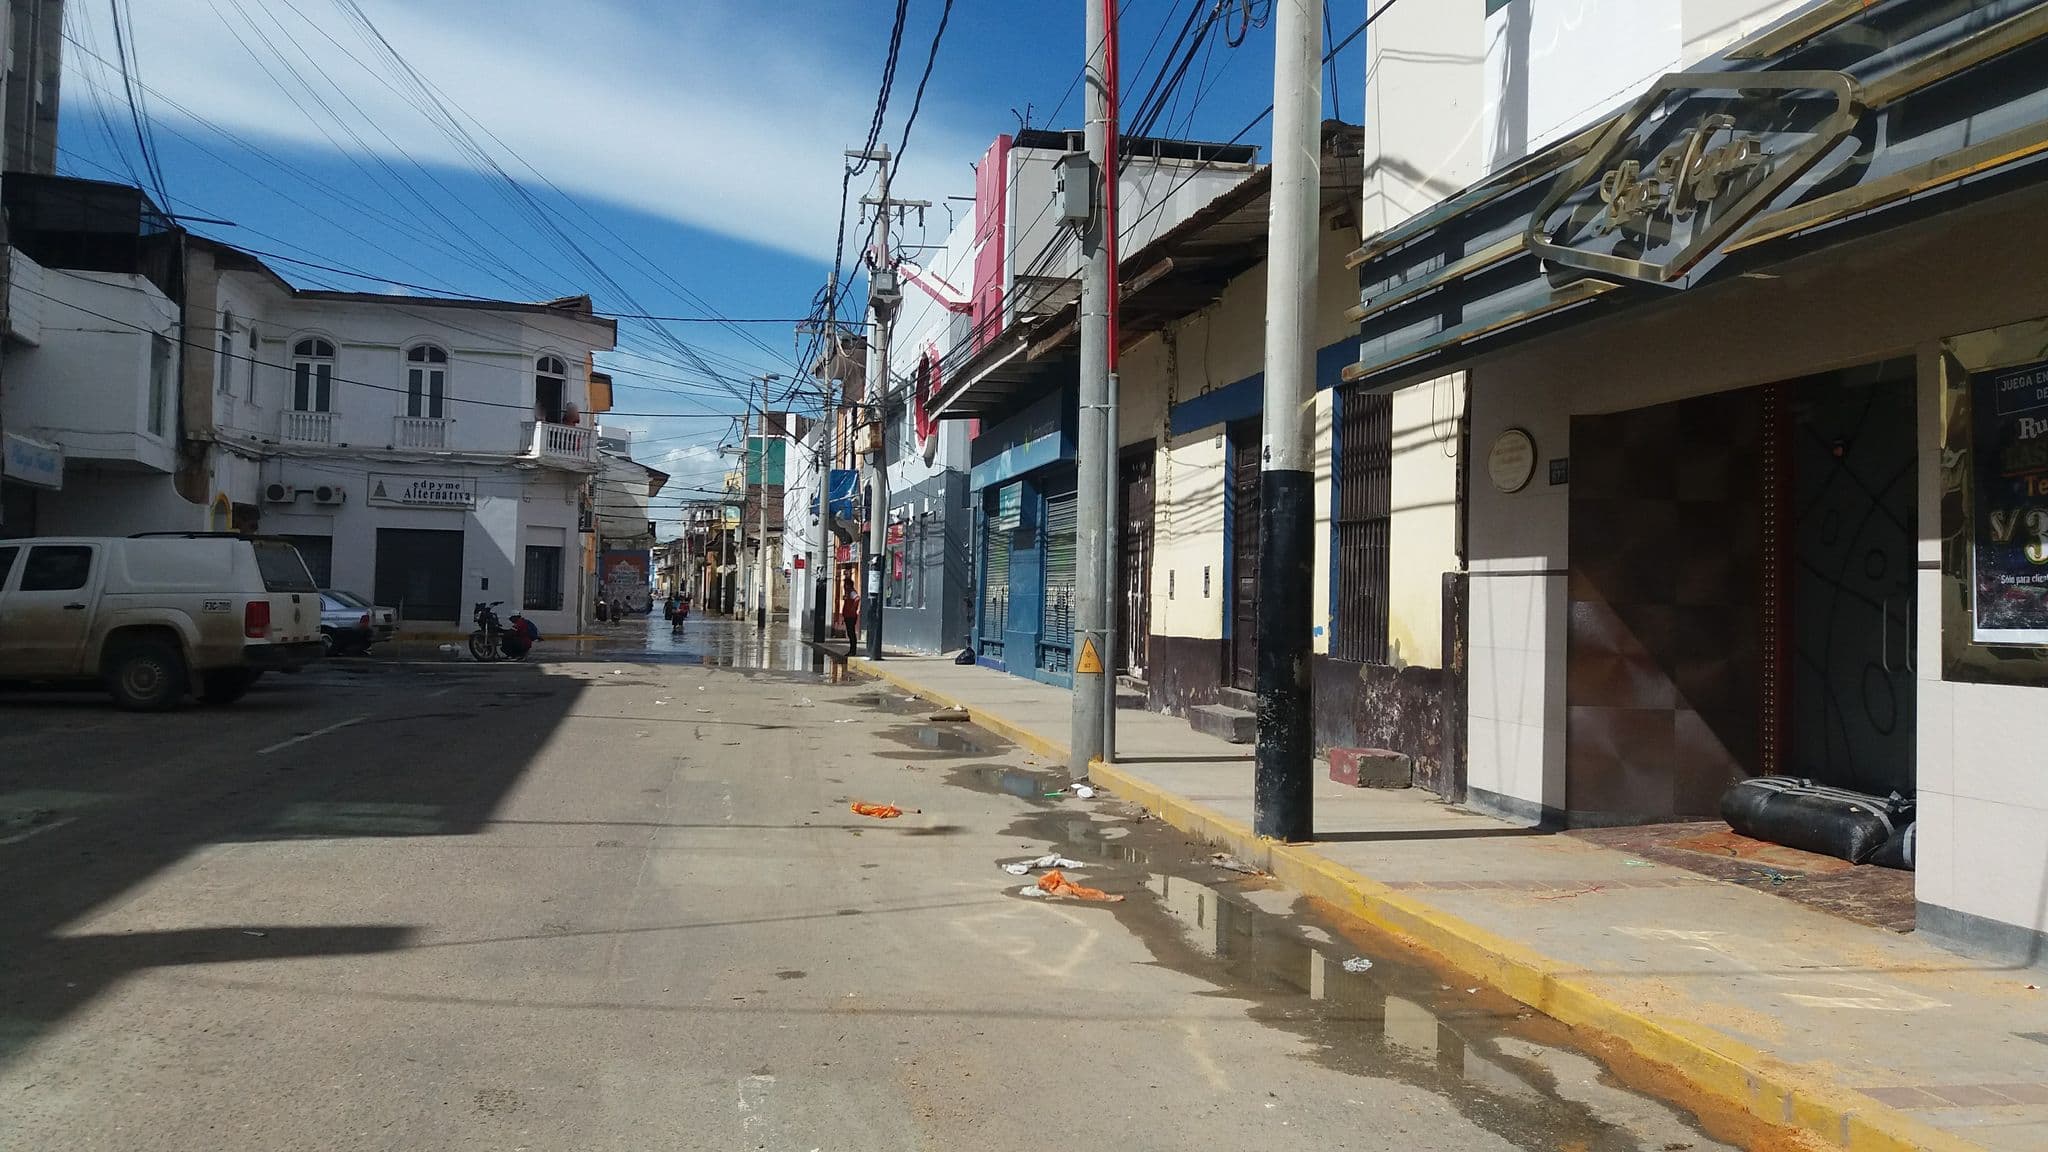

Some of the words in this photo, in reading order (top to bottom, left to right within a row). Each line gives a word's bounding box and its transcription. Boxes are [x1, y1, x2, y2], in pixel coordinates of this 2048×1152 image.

[2001, 375, 2033, 392] JUEGA
[413, 480, 460, 491] edpyme
[404, 488, 470, 501] Alternativa
